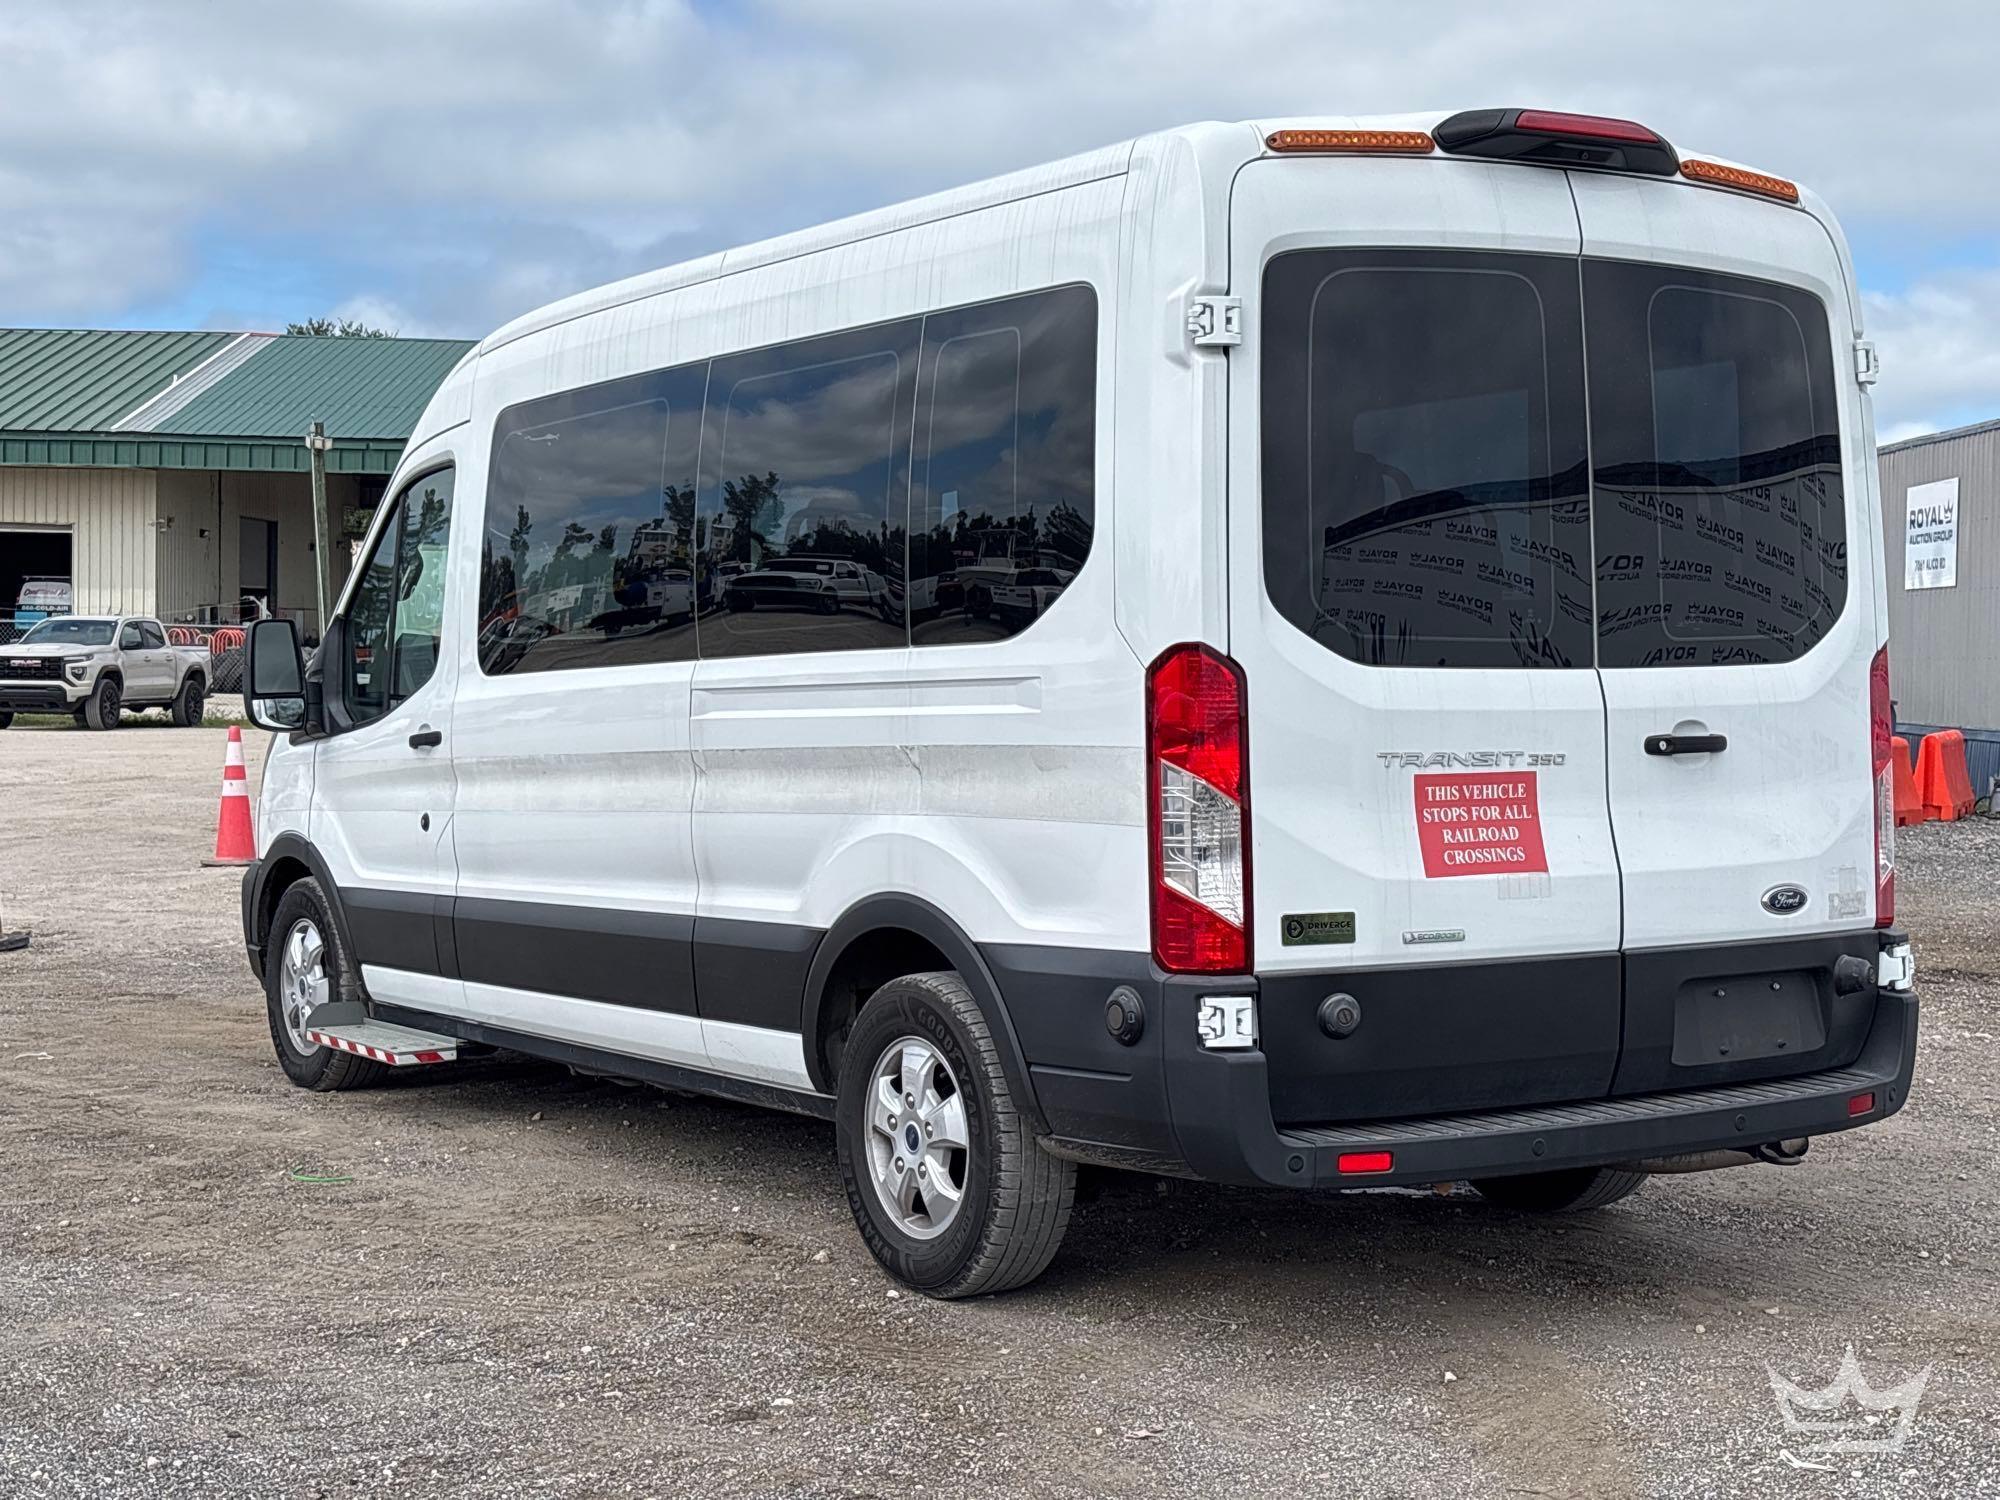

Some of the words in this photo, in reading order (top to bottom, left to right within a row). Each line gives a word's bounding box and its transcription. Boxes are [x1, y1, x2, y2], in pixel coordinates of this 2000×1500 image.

[1909, 505, 1943, 530] ROYAL
[1909, 532, 1932, 545] AUCTION
[1933, 529, 1953, 543] GROUP
[1377, 751, 1524, 768] TRANSIT
[1527, 753, 1566, 766] 350
[1425, 785, 1459, 801] THIS
[1462, 783, 1527, 800] VEHICLE
[1423, 806, 1468, 823] STOPS
[1471, 805, 1501, 821] FOR
[1504, 804, 1532, 820] ALL
[1442, 826, 1519, 844] RAILROAD
[1443, 847, 1526, 865] CROSSINGS
[1774, 891, 1800, 908] Ford
